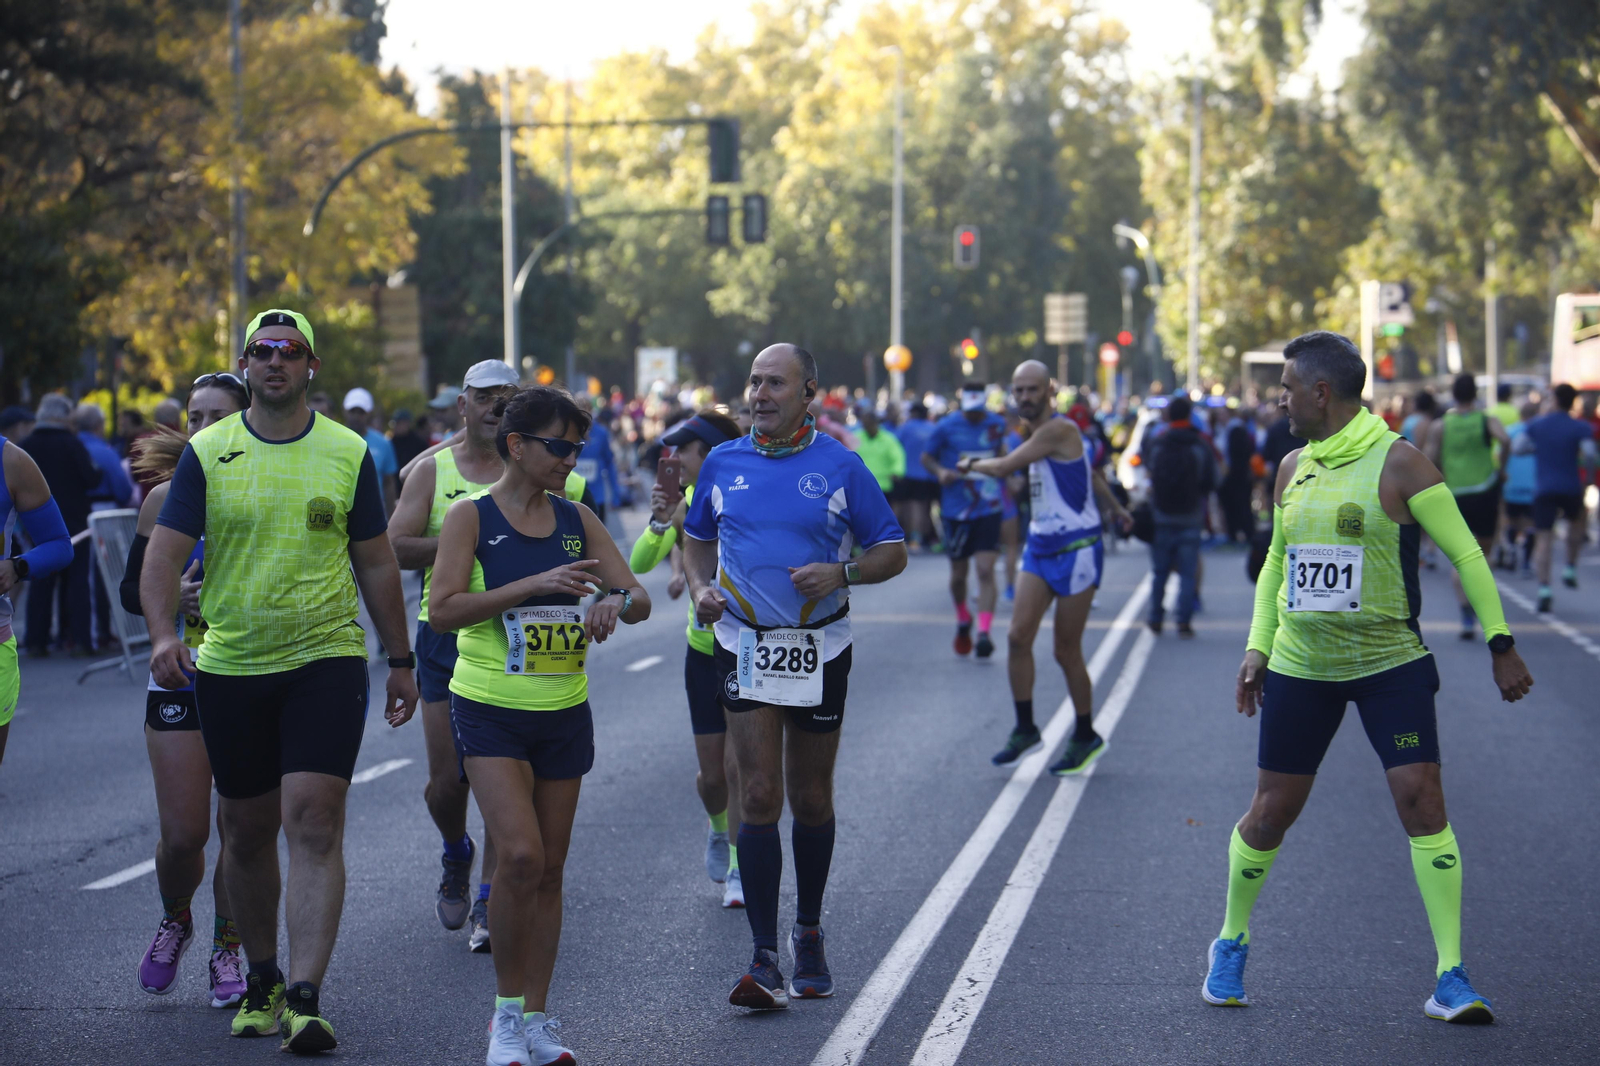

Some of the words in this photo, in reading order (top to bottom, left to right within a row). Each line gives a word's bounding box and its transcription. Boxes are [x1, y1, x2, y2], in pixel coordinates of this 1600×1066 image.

[1297, 562, 1352, 590] 3701
[529, 610, 561, 618] IMDECO
[513, 633, 521, 658] CAJÓN
[524, 625, 586, 651] 3712
[742, 652, 750, 676] CAJÓN
[755, 646, 818, 674] 3289
